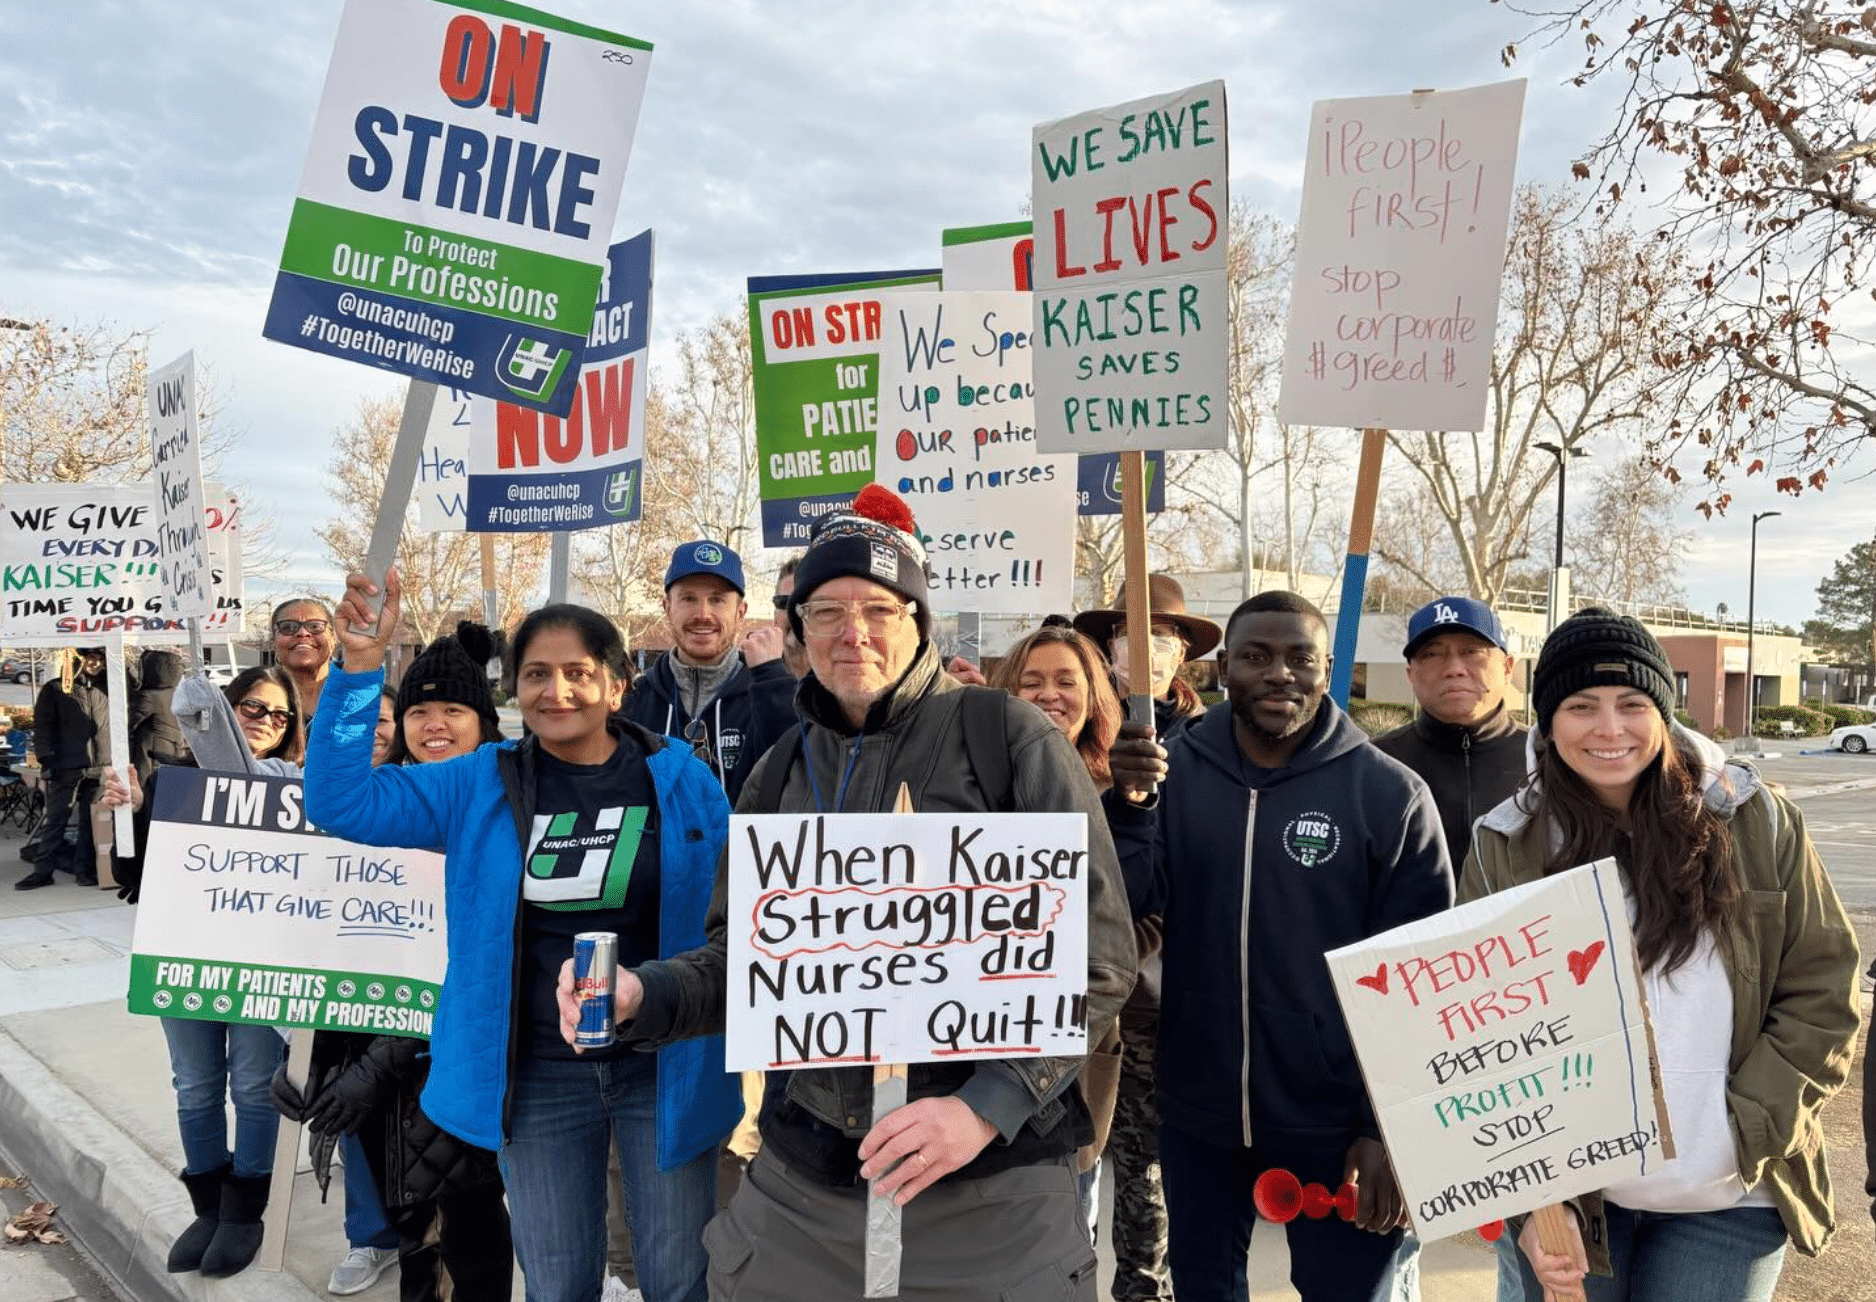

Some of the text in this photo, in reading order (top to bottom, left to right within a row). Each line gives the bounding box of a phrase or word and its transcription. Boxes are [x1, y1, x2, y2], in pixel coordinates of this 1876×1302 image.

[439, 14, 550, 124] ON
[602, 49, 634, 65] 250
[1039, 100, 1214, 182] WE SAVE
[347, 105, 600, 240] STRIKE
[1053, 178, 1218, 279] LIVES
[404, 230, 498, 271] To Protect
[332, 243, 384, 283] Our
[390, 255, 558, 321] Professions
[1321, 265, 1401, 314] stop
[337, 292, 456, 342] @unacuhcp
[585, 301, 633, 348] ACT
[772, 301, 881, 350] ON STR
[1042, 284, 1201, 348] KAISER
[1337, 295, 1477, 356] corporate
[301, 314, 475, 379] #TogetherWeRise
[899, 303, 956, 373] We
[836, 362, 868, 390] for
[1076, 351, 1180, 381] SAVES
[957, 374, 1034, 407] becau
[497, 357, 635, 470] NOW
[802, 398, 877, 439] PATIE
[1064, 394, 1212, 434] PENNIES
[421, 447, 466, 481] Hea
[769, 445, 872, 480] CARE and
[897, 463, 1056, 494] and nurses
[161, 470, 190, 516] Kaiser
[488, 503, 594, 524] #TogetherWeRise
[507, 483, 580, 502] @unacuhcp
[10, 506, 59, 531] WE
[68, 503, 149, 535] GIVE
[783, 522, 812, 540] #Tog
[42, 538, 126, 557] EVERY
[3, 563, 117, 591] KAISER
[923, 560, 1001, 590] etter
[7, 597, 74, 618] TIME
[87, 596, 134, 616] YOU
[56, 615, 186, 633] SUPPOR
[1433, 602, 1459, 624] LA
[201, 776, 268, 827] I'M
[542, 834, 615, 849] UNAC/UHCP
[1296, 820, 1330, 839] UTSC
[183, 844, 407, 886] SUPPORT THOSE
[747, 815, 1087, 890] When Kaiser
[204, 887, 274, 914] THAT
[275, 894, 332, 920] GIVE
[758, 883, 1041, 947] Struggled
[156, 961, 327, 1000] FOR MY PATIENTS
[749, 930, 1054, 1008] Nurses did
[1393, 914, 1553, 1007] PEOPLE
[240, 995, 281, 1021] AND
[286, 998, 321, 1024] MY
[1437, 970, 1554, 1042] FIRST
[775, 1007, 887, 1063] NOT
[1426, 1014, 1574, 1085] BEFORE
[1434, 1065, 1555, 1129] PROFIT
[1472, 1103, 1554, 1147] STOP
[1419, 1120, 1658, 1222] CORPORATE GREED!
